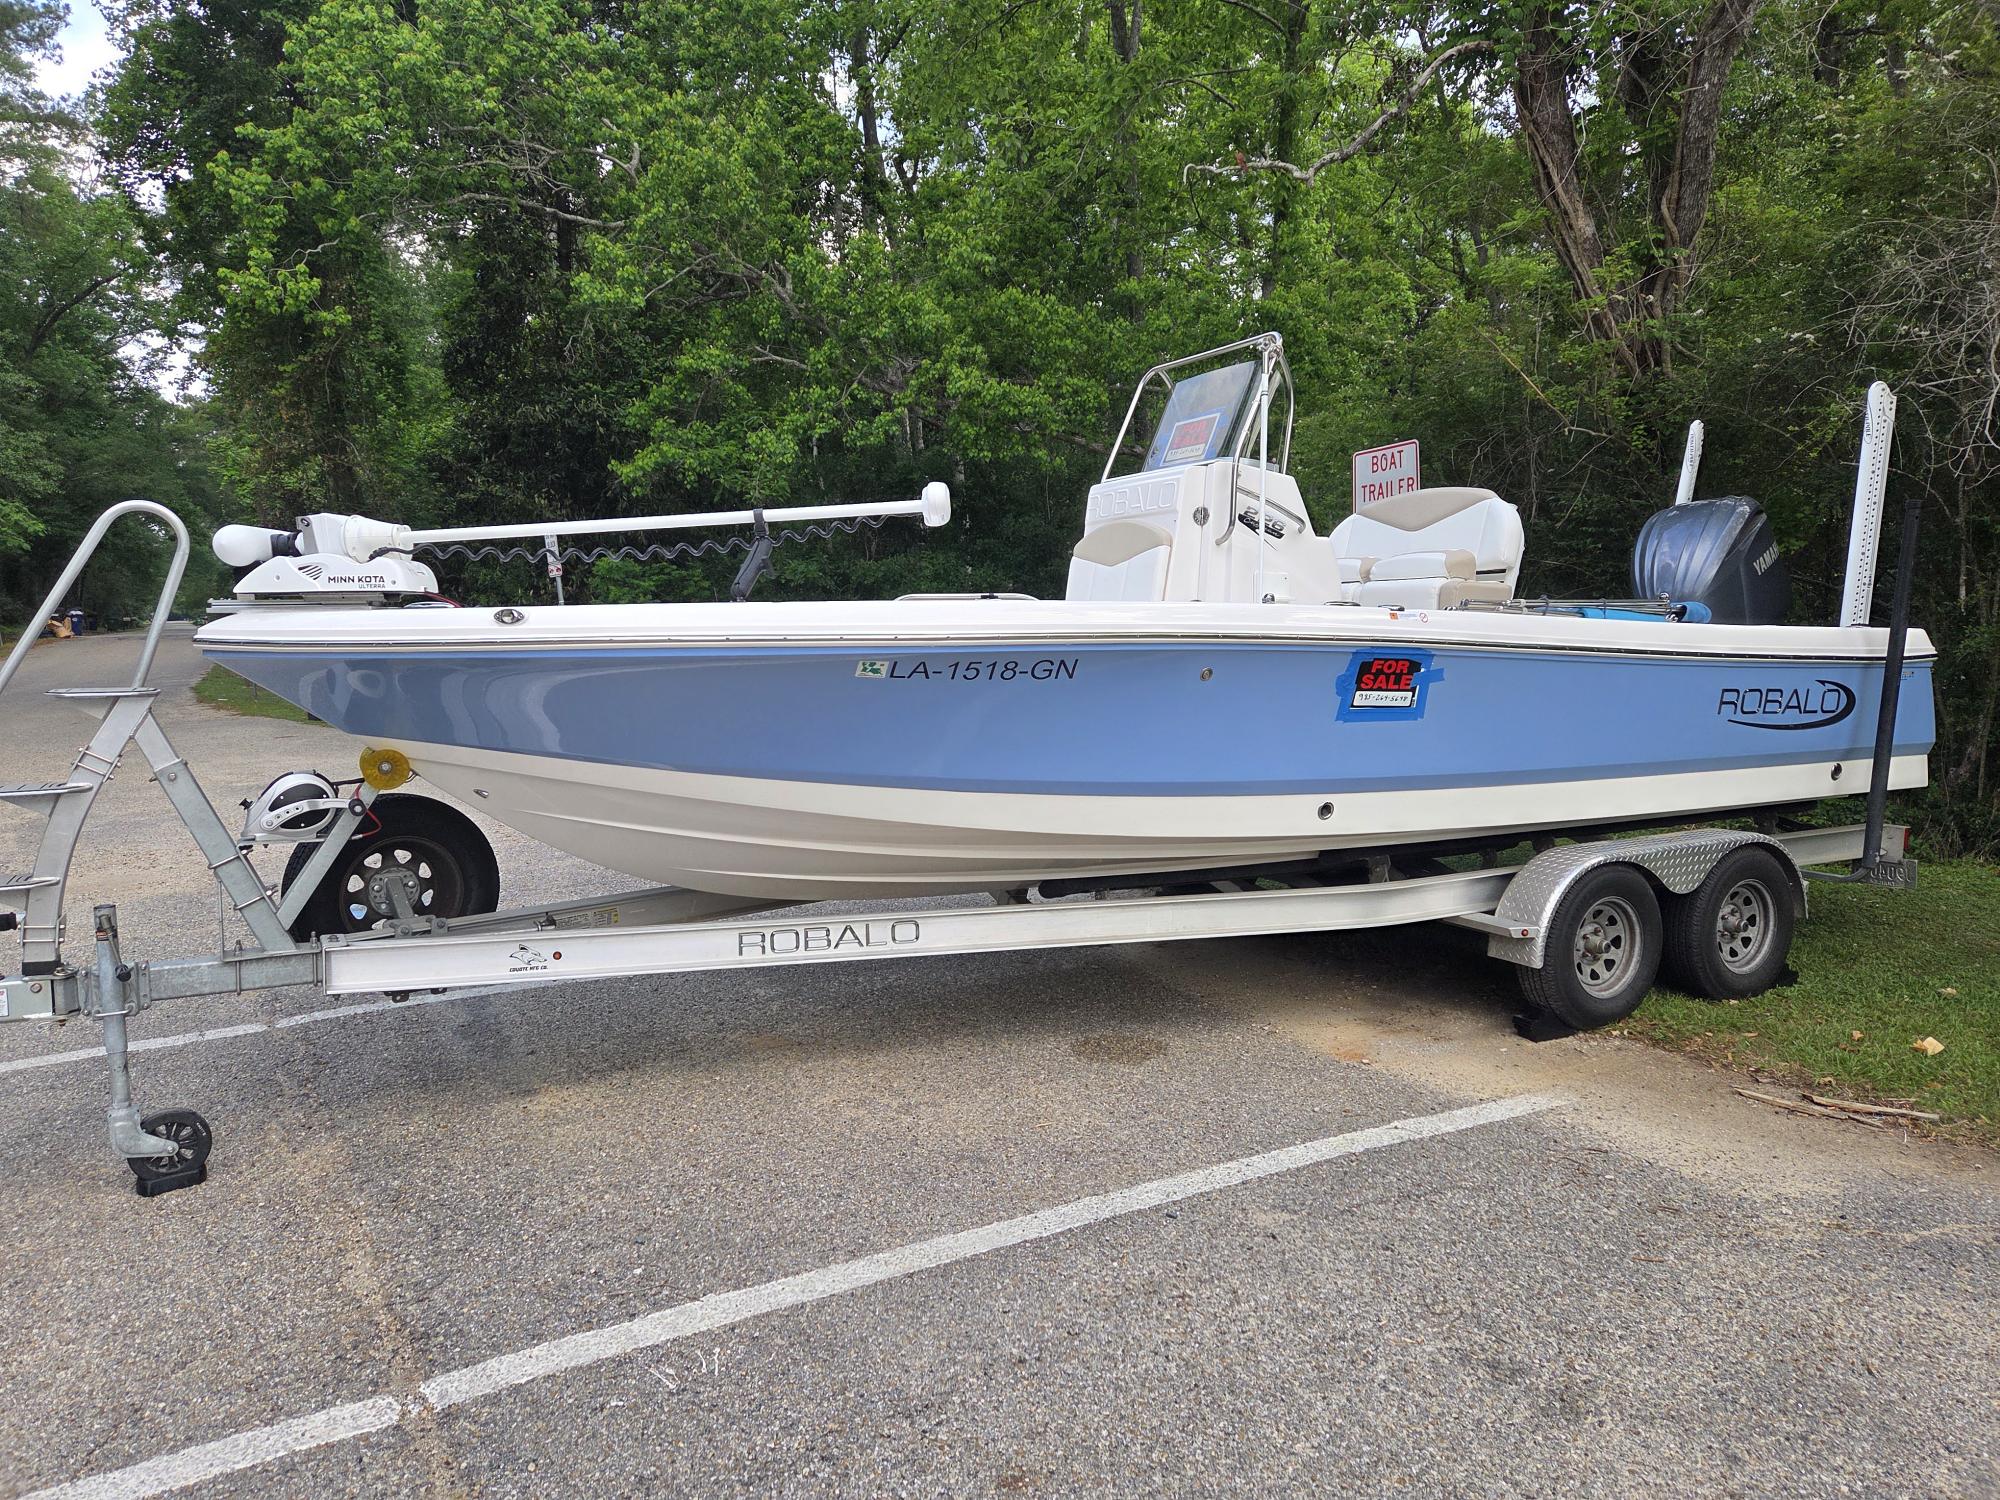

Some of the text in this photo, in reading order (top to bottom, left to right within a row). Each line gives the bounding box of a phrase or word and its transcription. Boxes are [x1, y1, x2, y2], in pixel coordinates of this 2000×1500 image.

[1371, 450, 1404, 473] BOAT
[1088, 481, 1177, 518] ROBALO
[1361, 477, 1415, 503] TRAILER
[357, 575, 385, 583] KOTA
[889, 658, 1079, 681] LA-1518-GN
[1371, 660, 1409, 673] FOR
[1360, 674, 1413, 689] SALE
[1717, 688, 1841, 715] ROBALO
[738, 920, 920, 956] ROBALO
